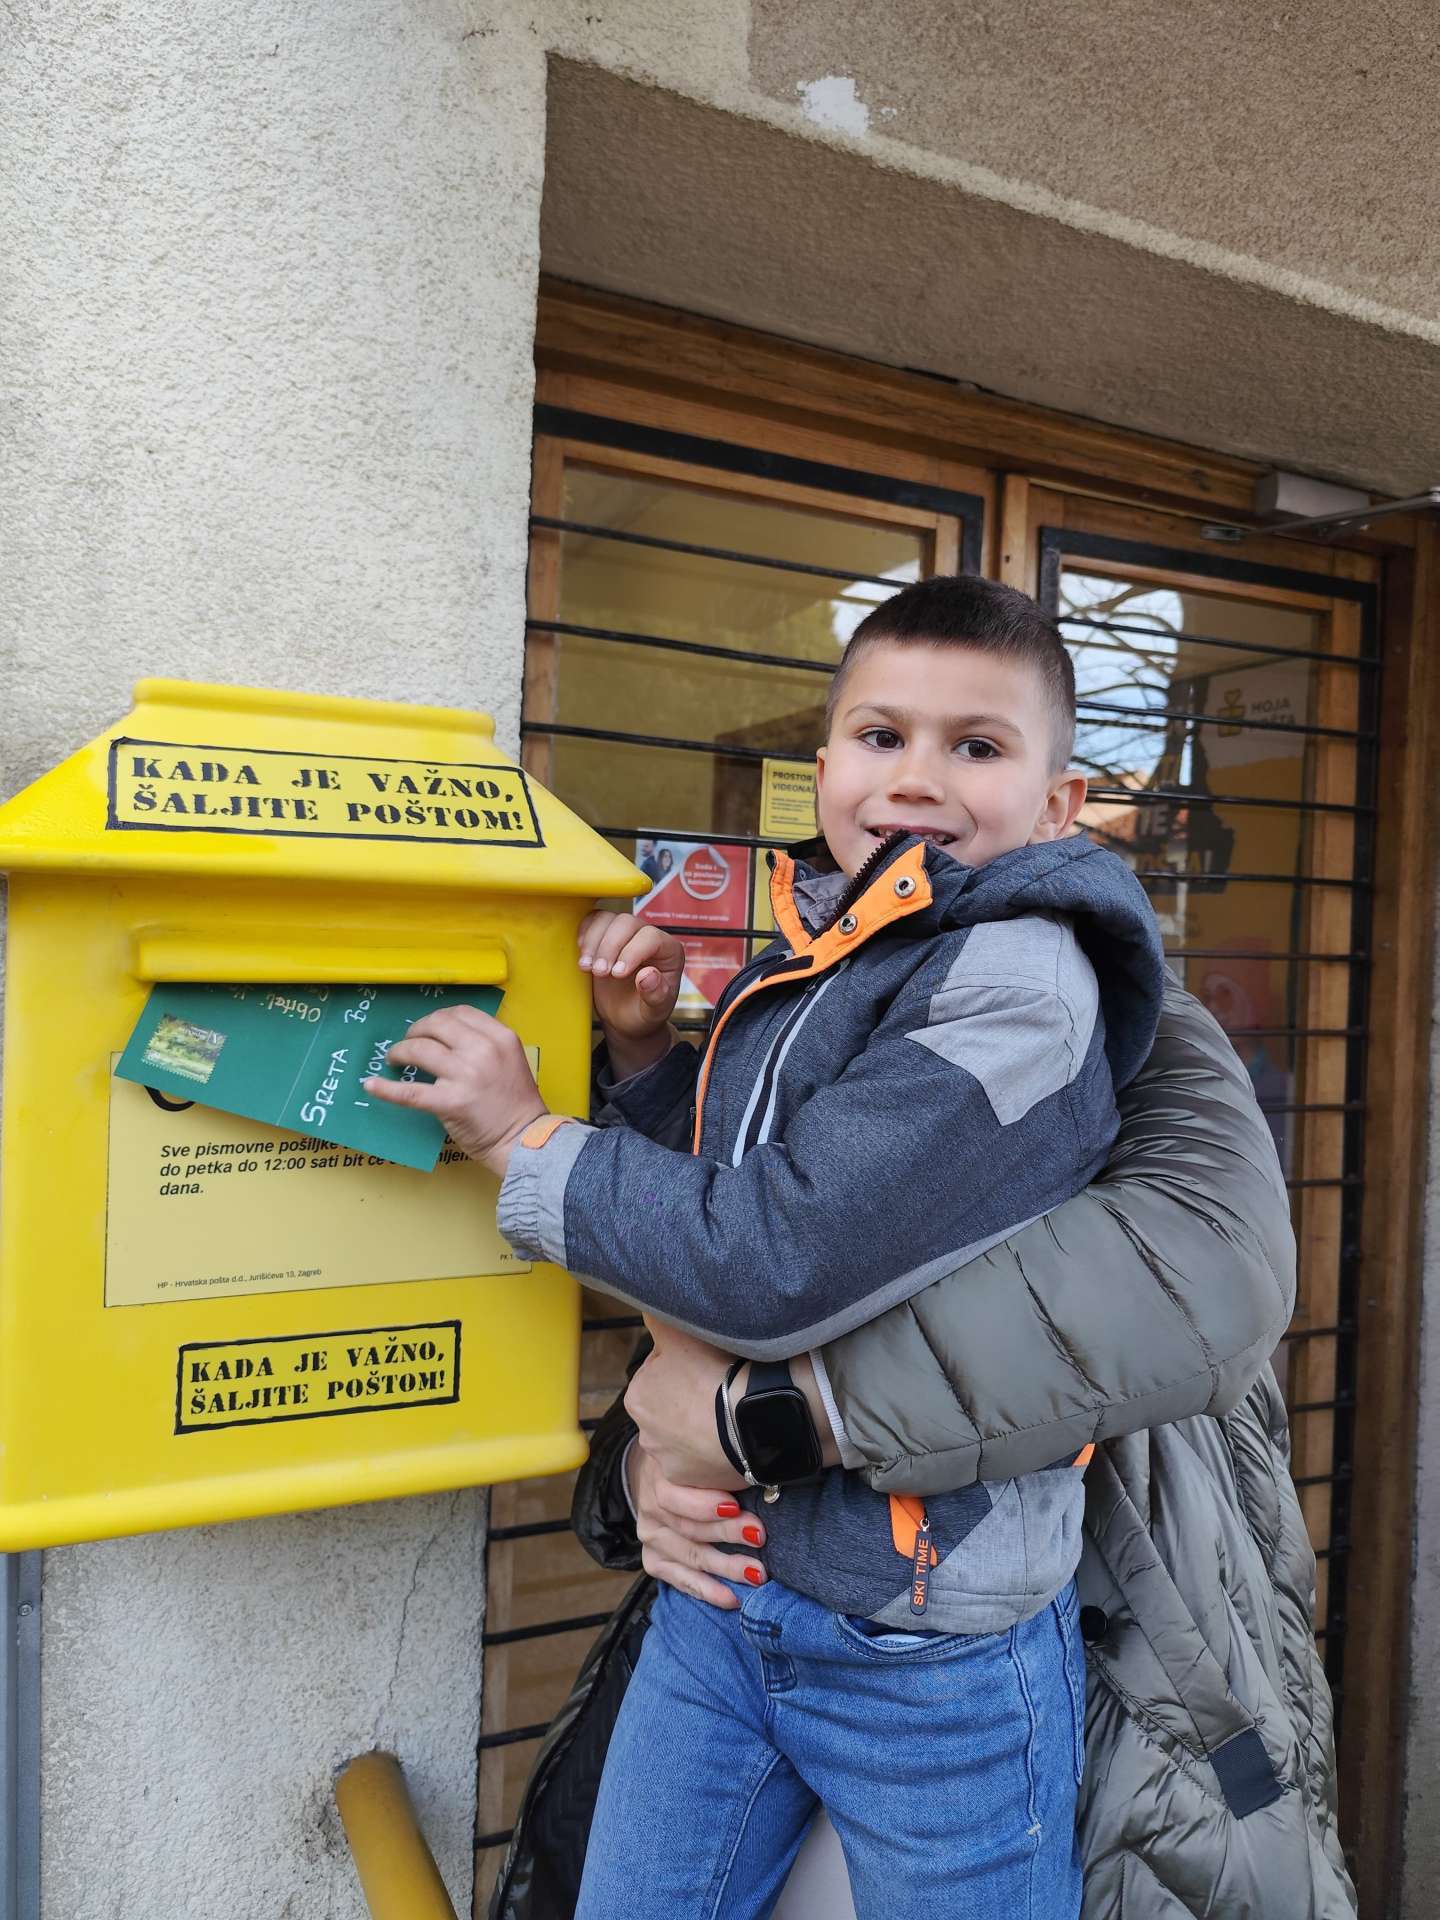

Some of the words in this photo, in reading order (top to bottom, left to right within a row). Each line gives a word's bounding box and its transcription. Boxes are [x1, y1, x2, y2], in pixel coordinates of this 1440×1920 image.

[132, 756, 262, 786] KADA
[291, 768, 342, 792] JE
[368, 769, 514, 803] VAŽNO,
[772, 771, 813, 782] PROSTOR
[132, 783, 319, 822] ŠALJITE
[347, 802, 524, 831] POŠTOM!
[160, 1145, 191, 1158] Sve
[195, 1142, 275, 1159] pismovne
[278, 1136, 339, 1155] pošiljke
[160, 1163, 181, 1177] do
[185, 1160, 233, 1178] petka
[238, 1159, 258, 1172] do
[264, 1157, 306, 1171] 12:00
[310, 1154, 338, 1169] sati
[343, 1152, 365, 1168] bit
[159, 1182, 204, 1196] dana.
[175, 1279, 208, 1288] Hrvatska
[209, 1276, 230, 1286] pošta
[297, 1269, 322, 1278] Zagreb
[190, 1356, 275, 1384] KADA
[294, 1351, 328, 1373] JE
[347, 1336, 446, 1367] VAŽNO,
[190, 1383, 309, 1415] ŠALJITE
[327, 1370, 446, 1401] POŠTOM!
[916, 1539, 928, 1575] TIME
[914, 1581, 925, 1605] SKI
